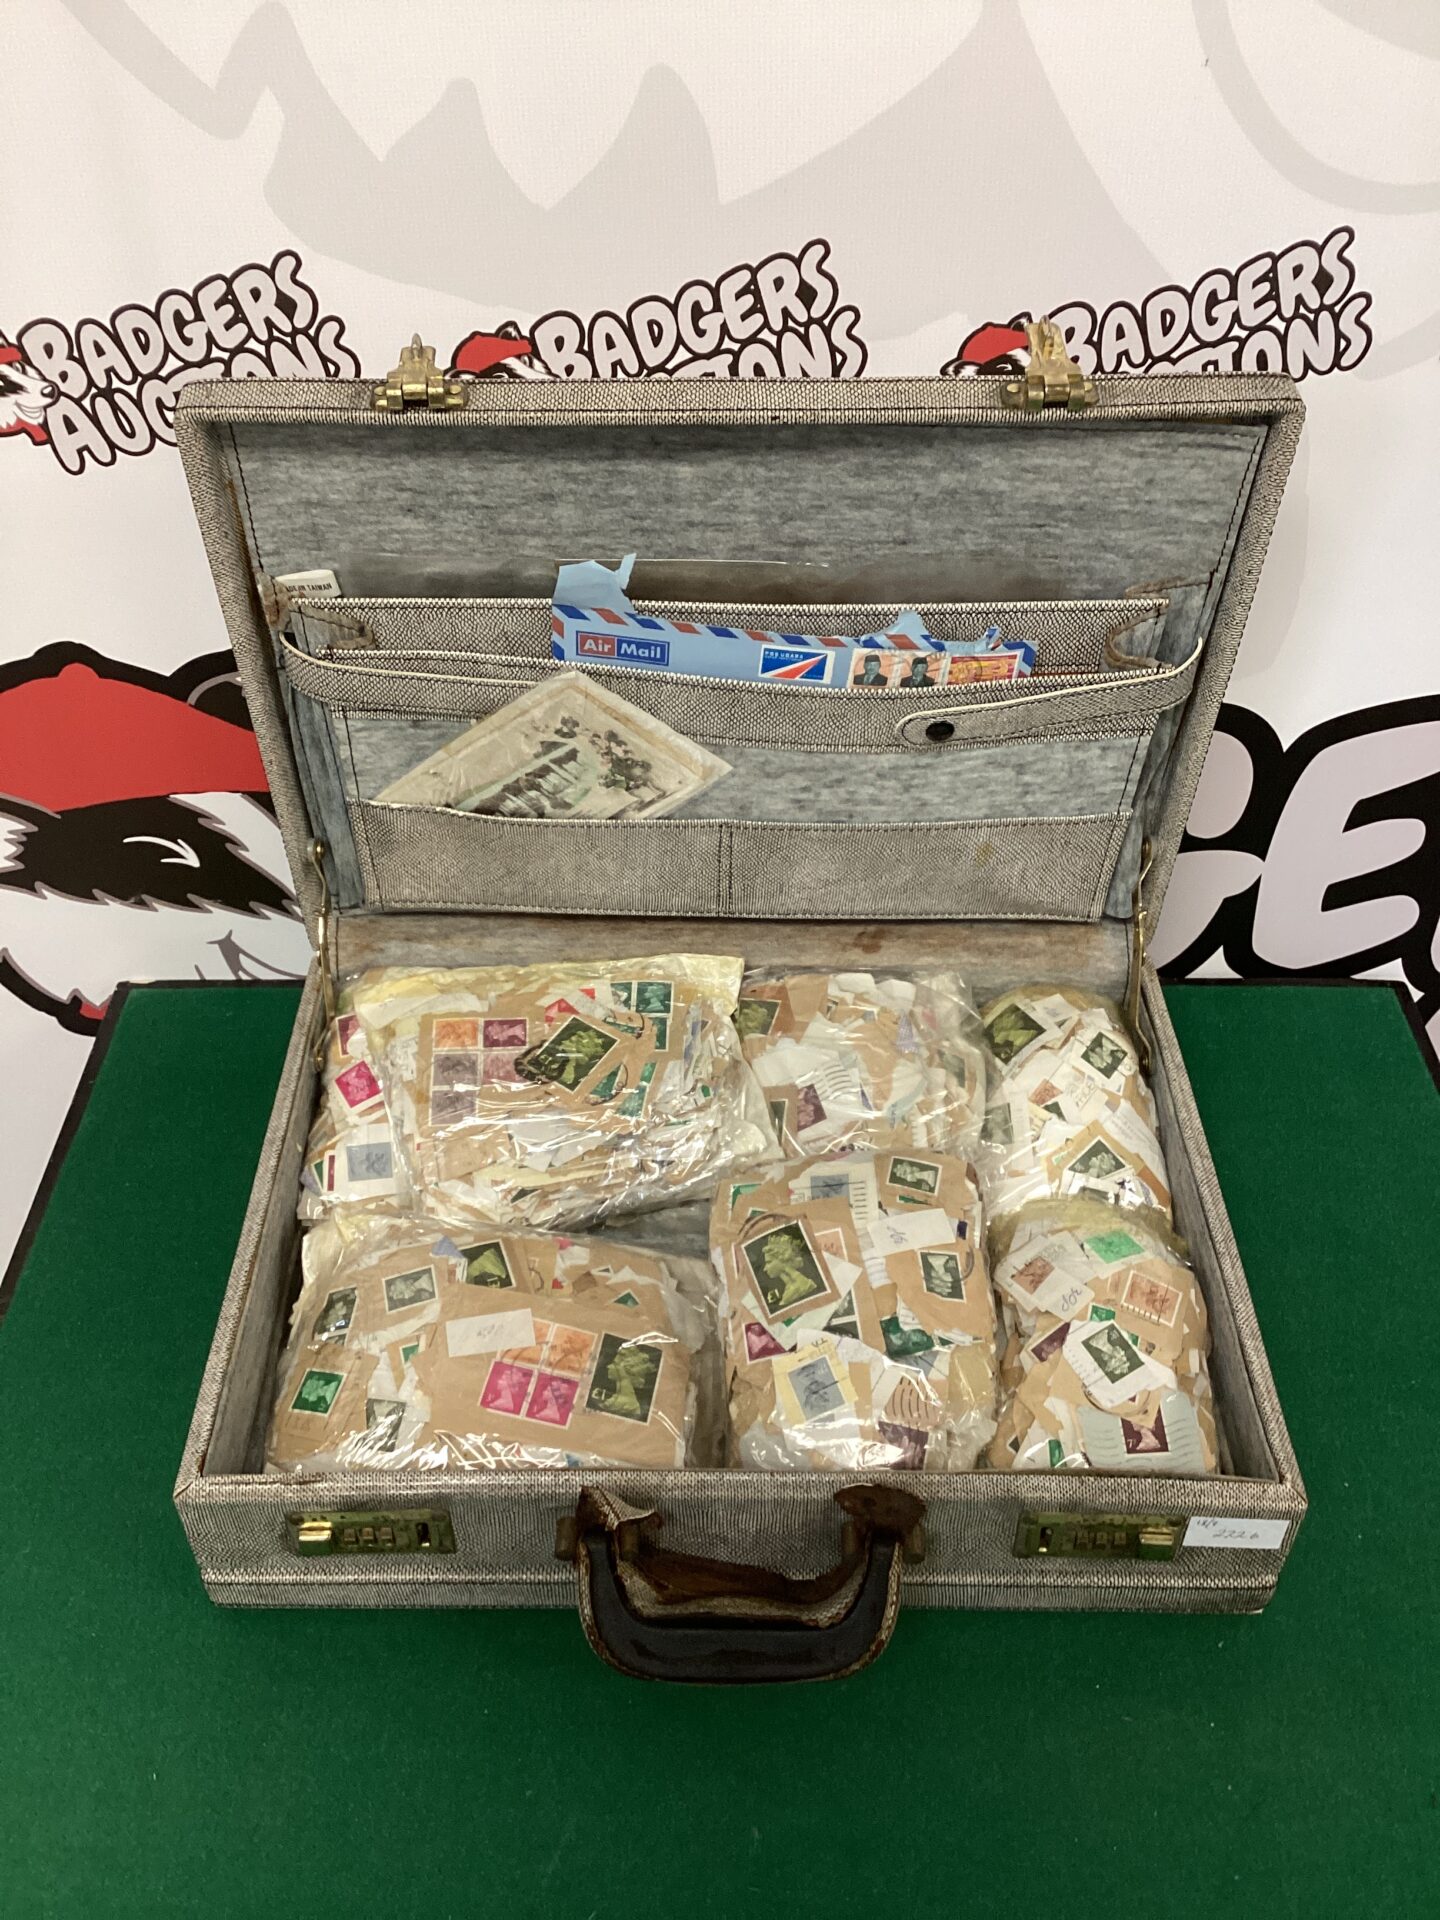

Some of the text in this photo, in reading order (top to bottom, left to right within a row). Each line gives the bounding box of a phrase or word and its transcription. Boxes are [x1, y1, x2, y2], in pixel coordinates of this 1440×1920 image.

[16, 249, 318, 401] BADGERS
[529, 238, 840, 378] BADGERS
[1047, 225, 1356, 375] BADGERS
[307, 582, 333, 591] TAIWAN
[583, 639, 662, 660] Air Mail
[591, 1387, 606, 1401] £1
